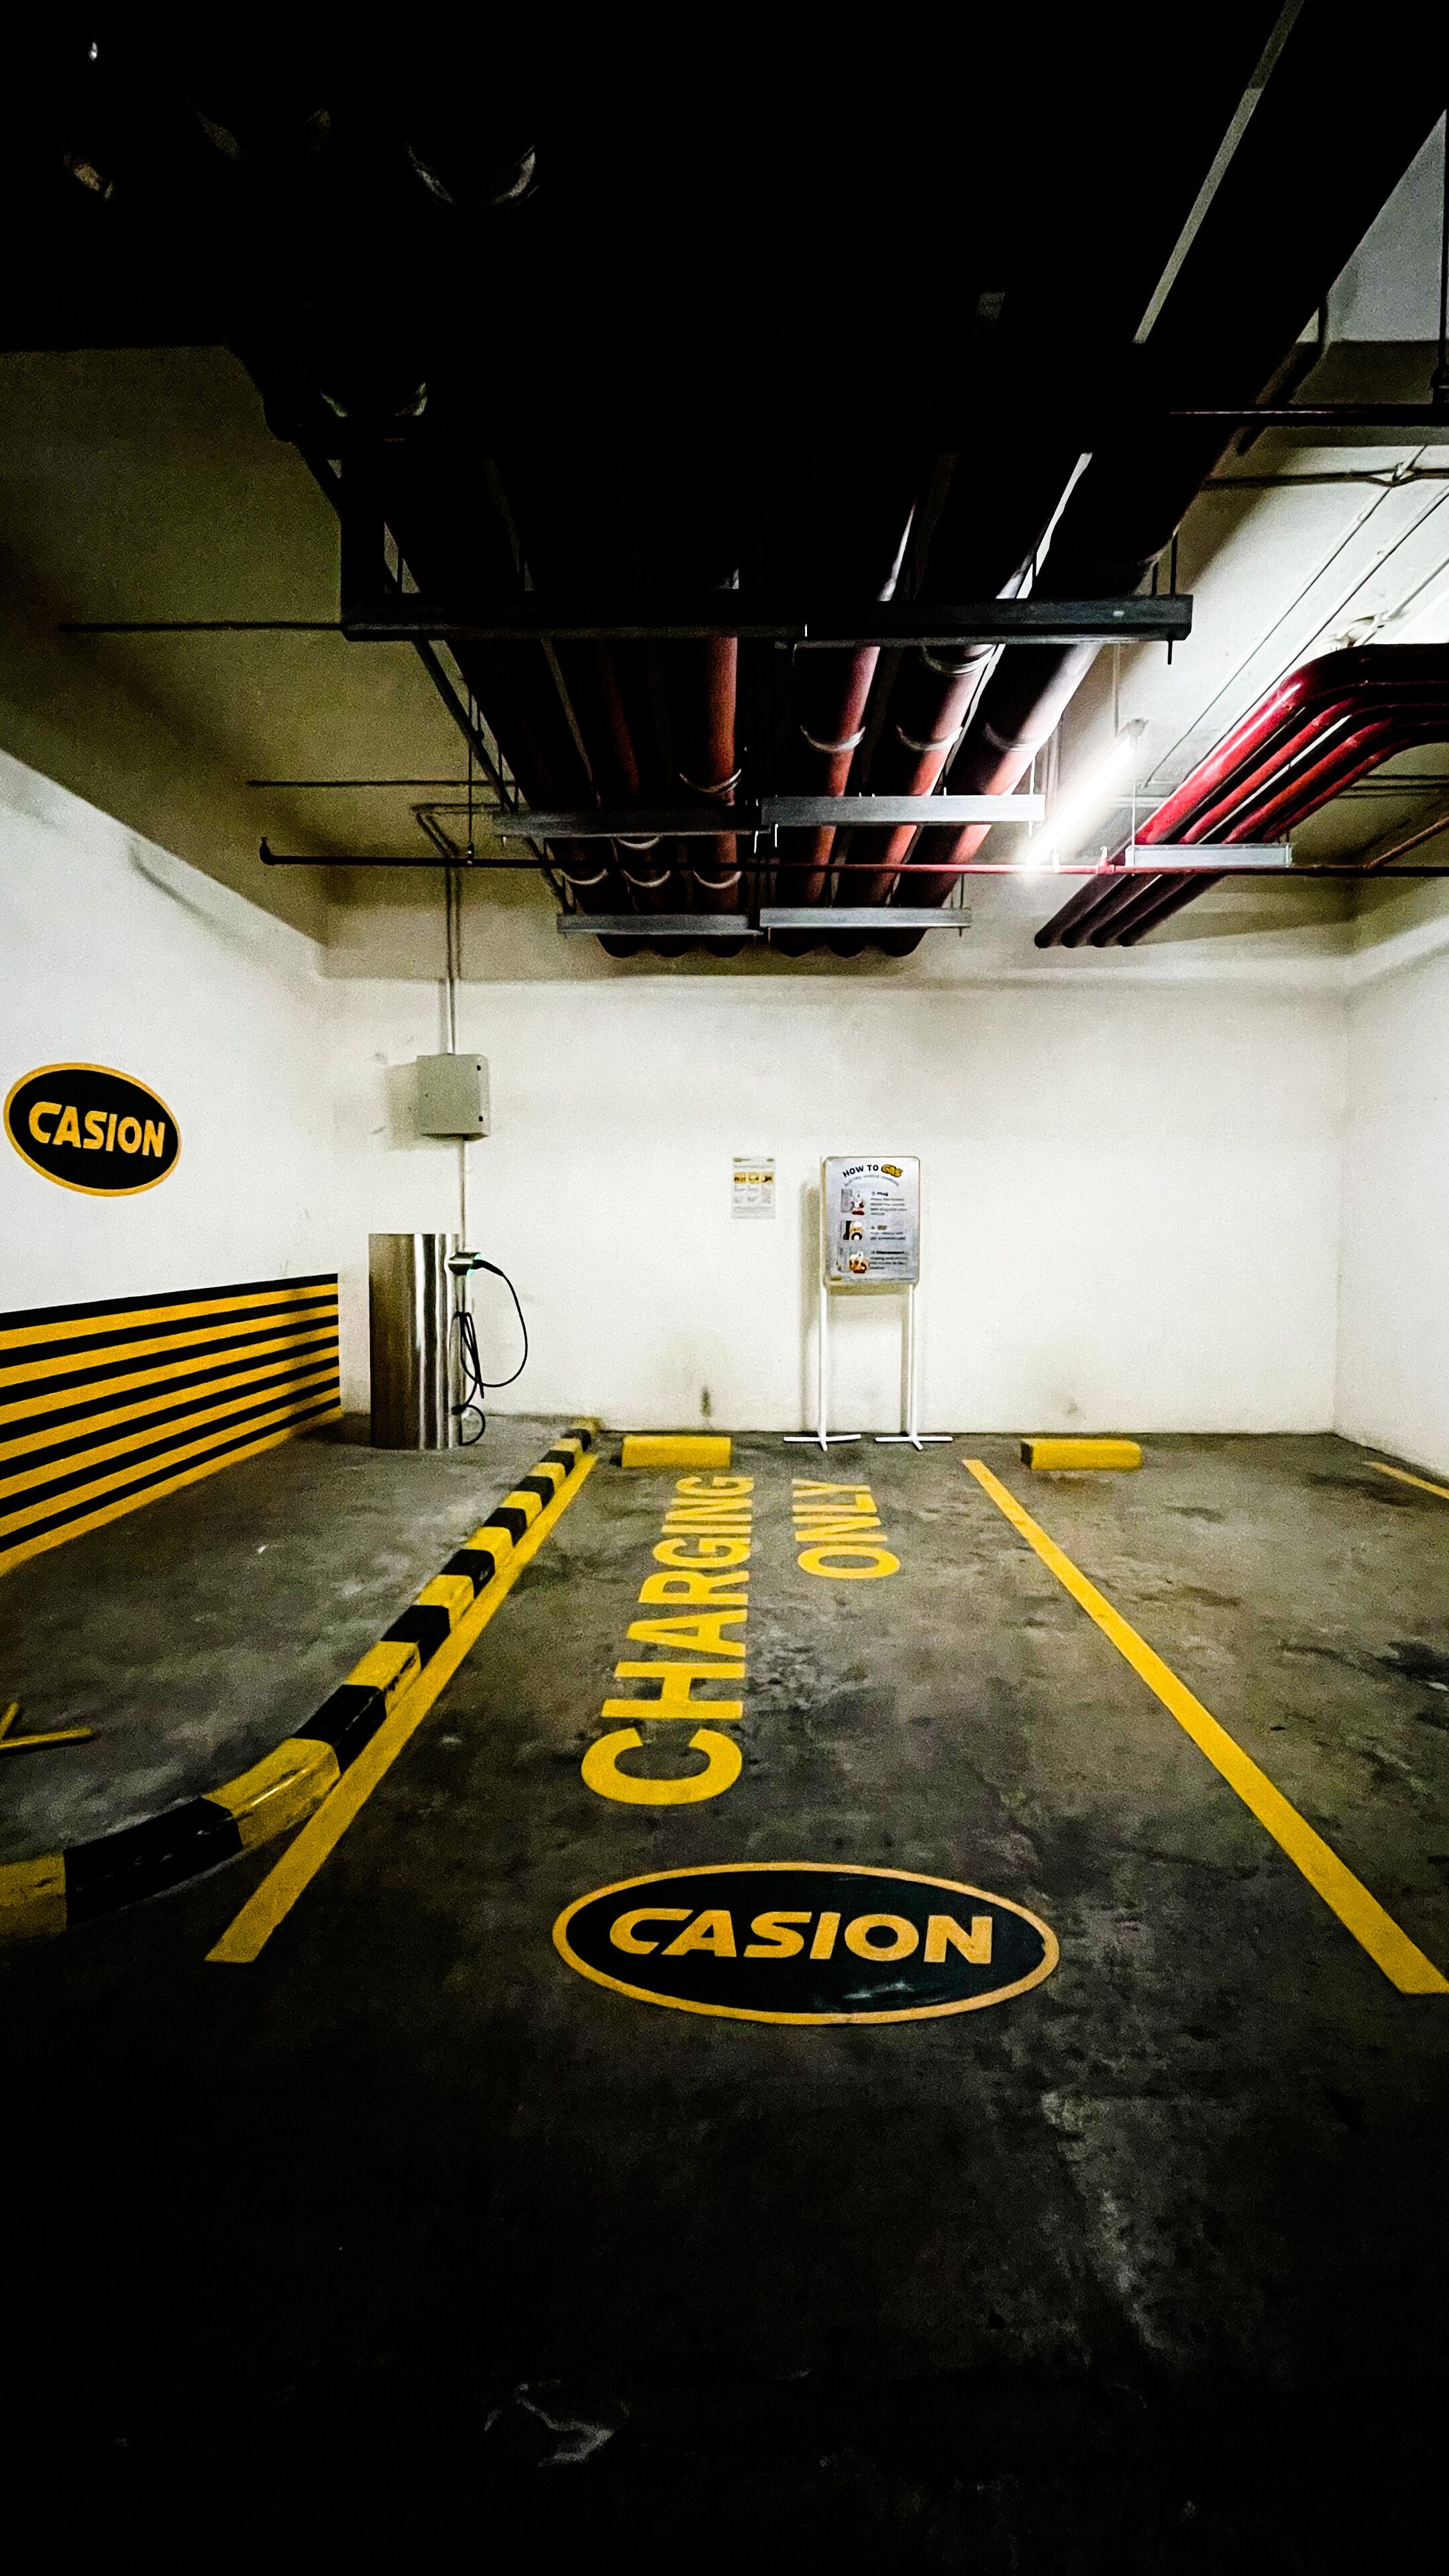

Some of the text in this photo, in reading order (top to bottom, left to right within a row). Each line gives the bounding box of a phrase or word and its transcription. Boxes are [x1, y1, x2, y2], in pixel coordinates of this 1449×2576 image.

[29, 1101, 166, 1158] CASION
[843, 1165, 864, 1177] HOW
[792, 1479, 901, 1580] ONLY
[581, 1476, 754, 1806] CHARGING
[610, 1908, 993, 1964] CASION
